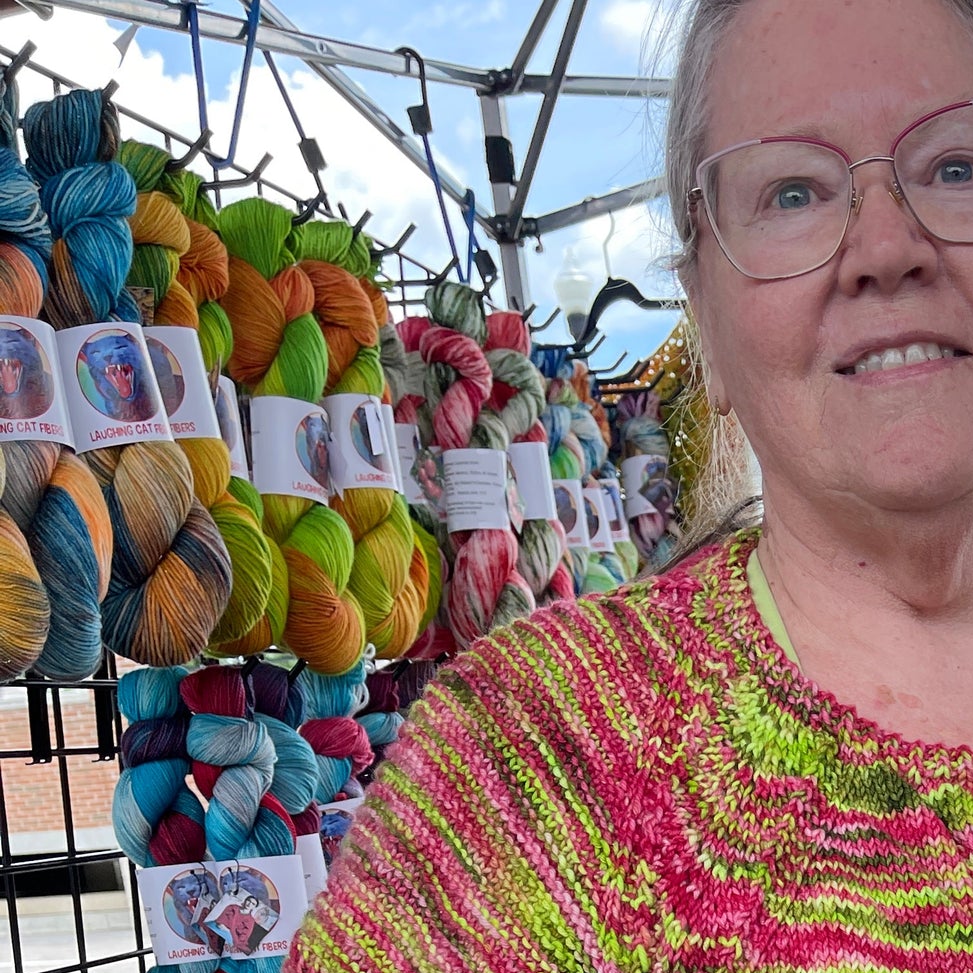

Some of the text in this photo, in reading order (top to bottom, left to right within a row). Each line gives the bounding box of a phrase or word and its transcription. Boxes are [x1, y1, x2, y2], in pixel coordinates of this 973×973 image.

[17, 421, 37, 433] CAT
[89, 425, 134, 442] LAUGHING
[135, 423, 153, 435] CAT
[262, 940, 288, 952] FIBERS
[168, 946, 206, 959] LAUGHING
